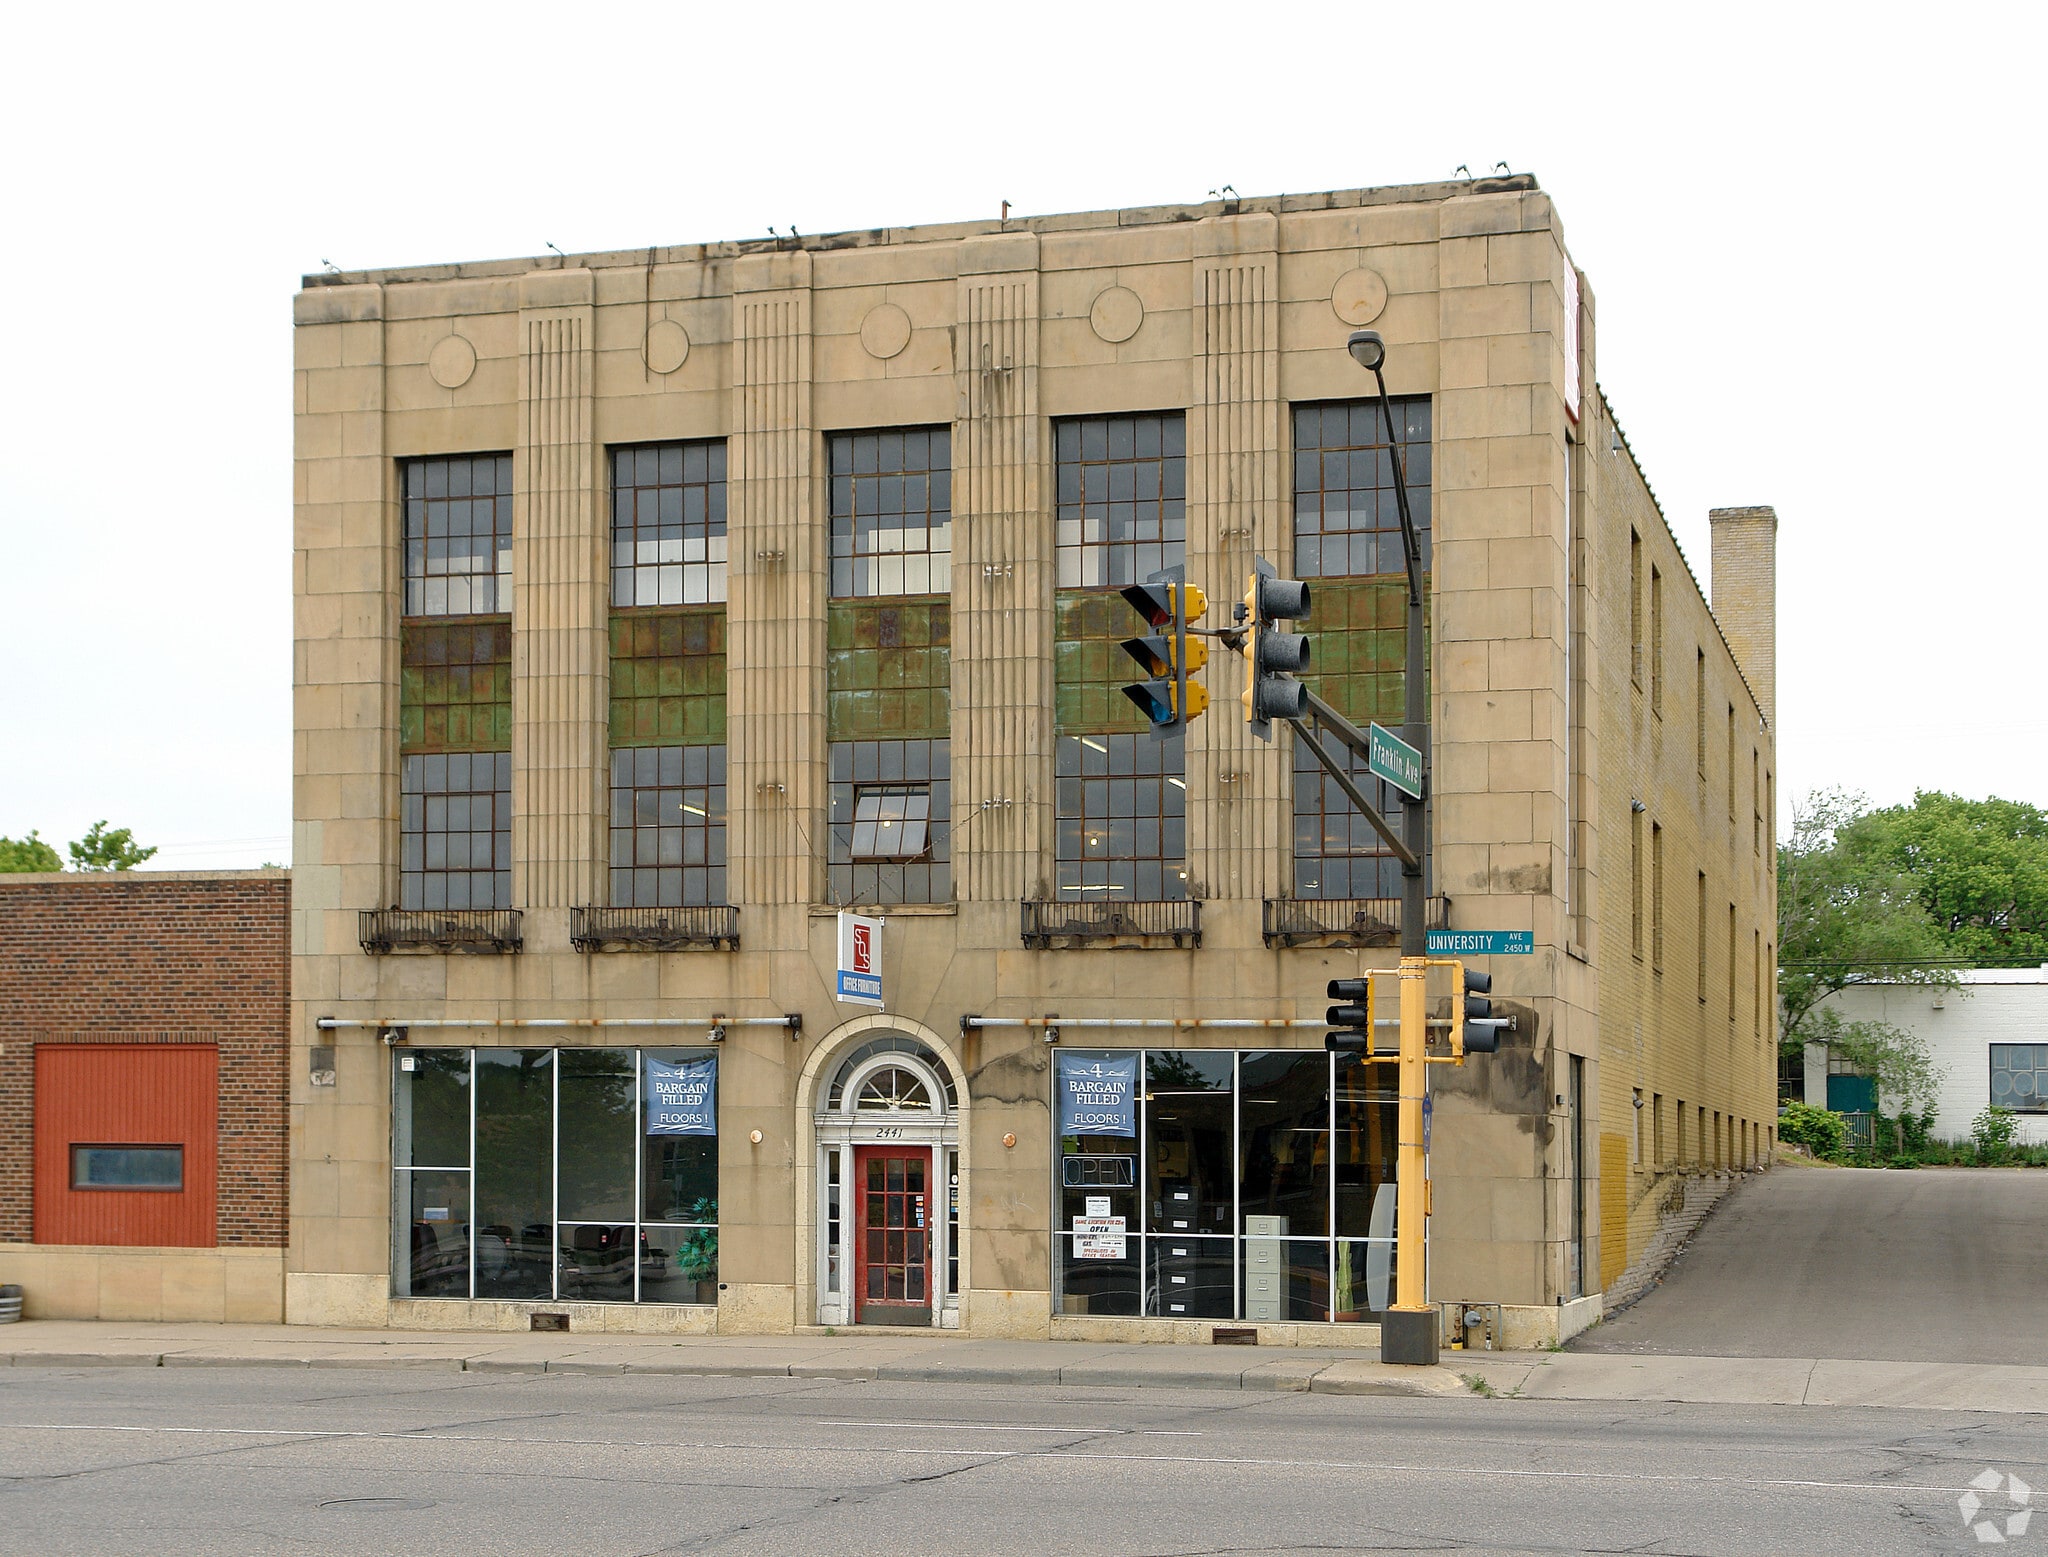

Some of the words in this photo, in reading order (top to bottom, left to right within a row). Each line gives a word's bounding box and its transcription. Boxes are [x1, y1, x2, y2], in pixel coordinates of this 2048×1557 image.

[1373, 735, 1403, 776] Franklin
[1405, 757, 1418, 784] Ave
[1508, 932, 1523, 940] AVE
[854, 928, 870, 969] SOS
[1429, 935, 1493, 950] UNIVERSITY
[1504, 944, 1523, 953] 2450
[1524, 944, 1531, 953] W
[843, 976, 858, 993] OFFICE
[857, 978, 881, 996] FURNITURE
[674, 1067, 686, 1080] 4
[1090, 1063, 1103, 1078] 4
[656, 1082, 708, 1094] BARGAIN
[1069, 1081, 1126, 1093] BARGAIN
[662, 1094, 703, 1106] FILLED
[1076, 1093, 1120, 1105] FILLED
[876, 1127, 904, 1138] 2441
[1065, 1158, 1132, 1185] OPEN
